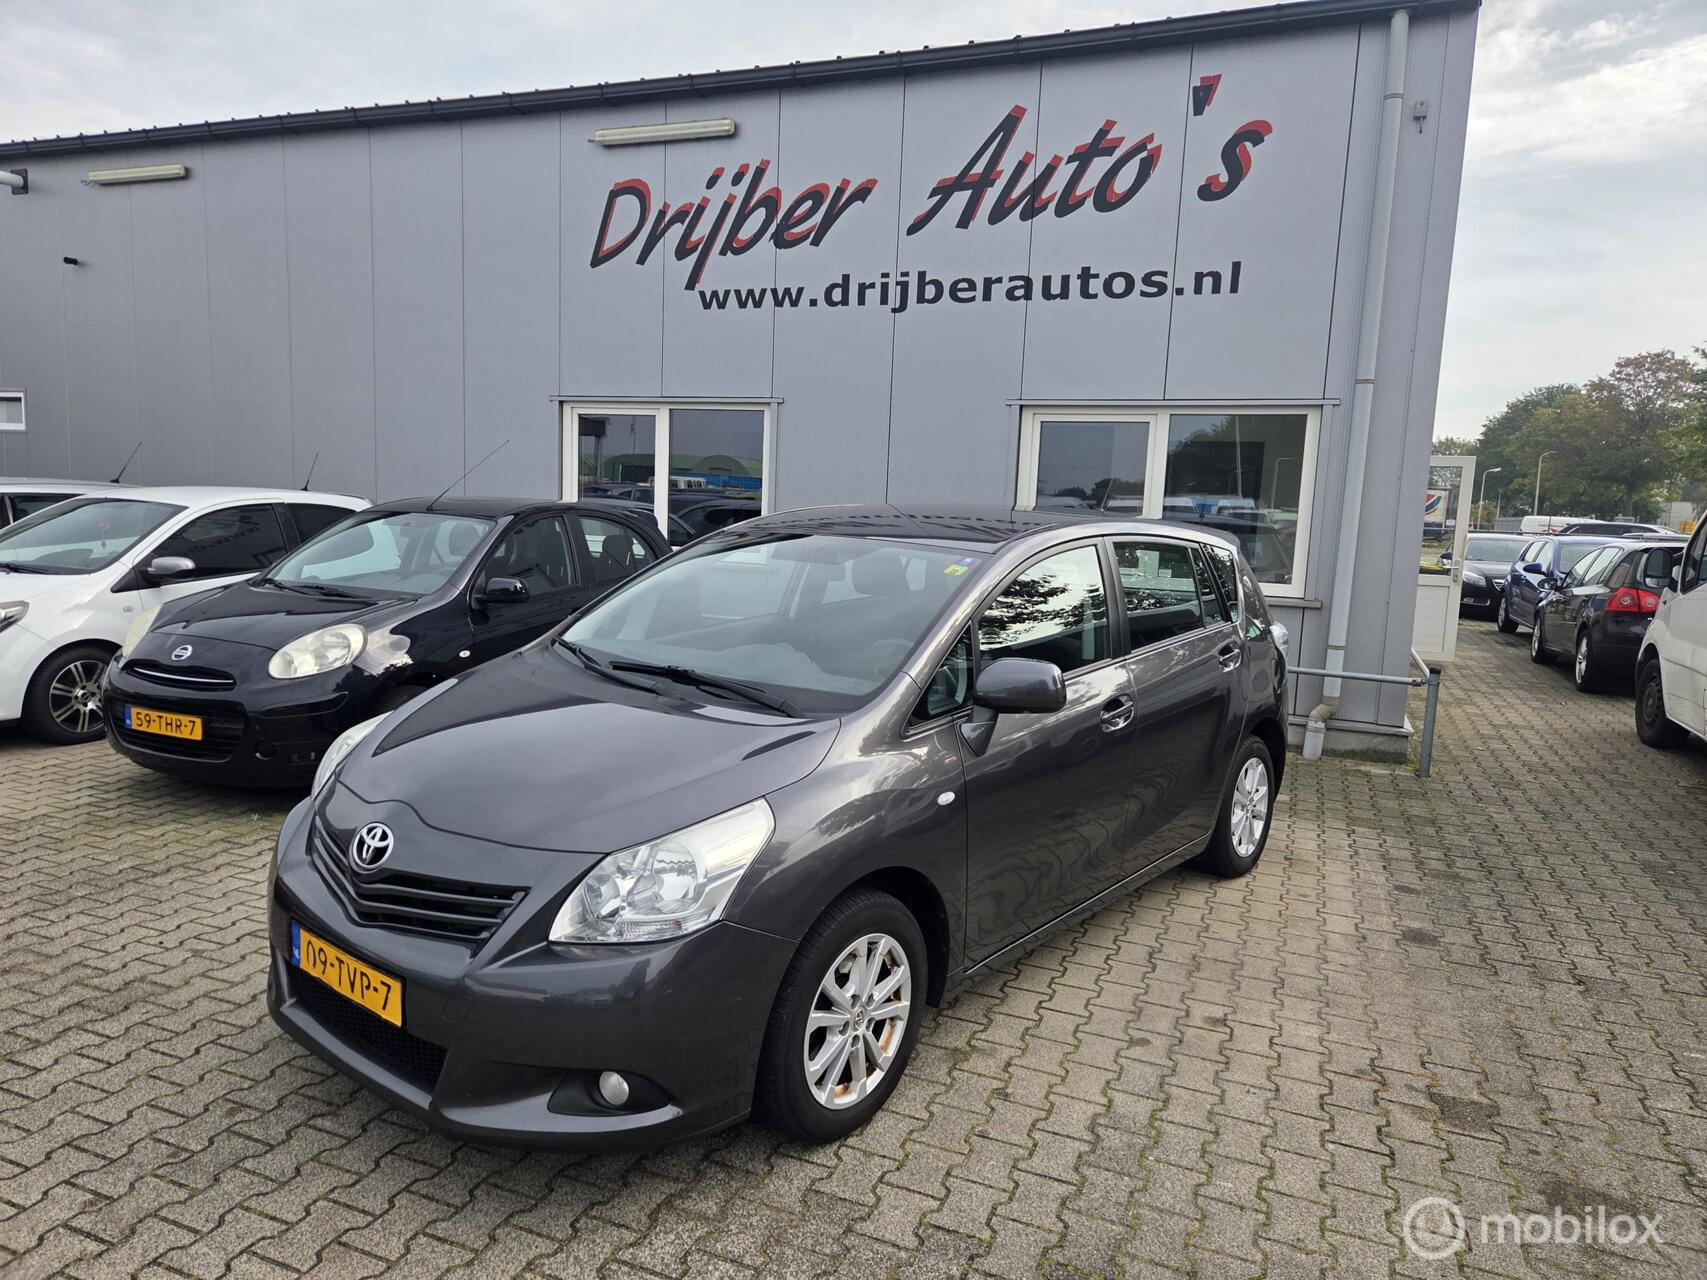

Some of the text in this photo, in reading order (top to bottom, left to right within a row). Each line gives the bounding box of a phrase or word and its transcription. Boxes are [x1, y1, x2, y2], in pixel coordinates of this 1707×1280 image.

[589, 73, 1273, 291] Drijber Auto's
[698, 261, 1242, 313] www.drijberautos.nl
[135, 711, 196, 736] 59-THR-7
[306, 940, 392, 1011] 09-TVP-7
